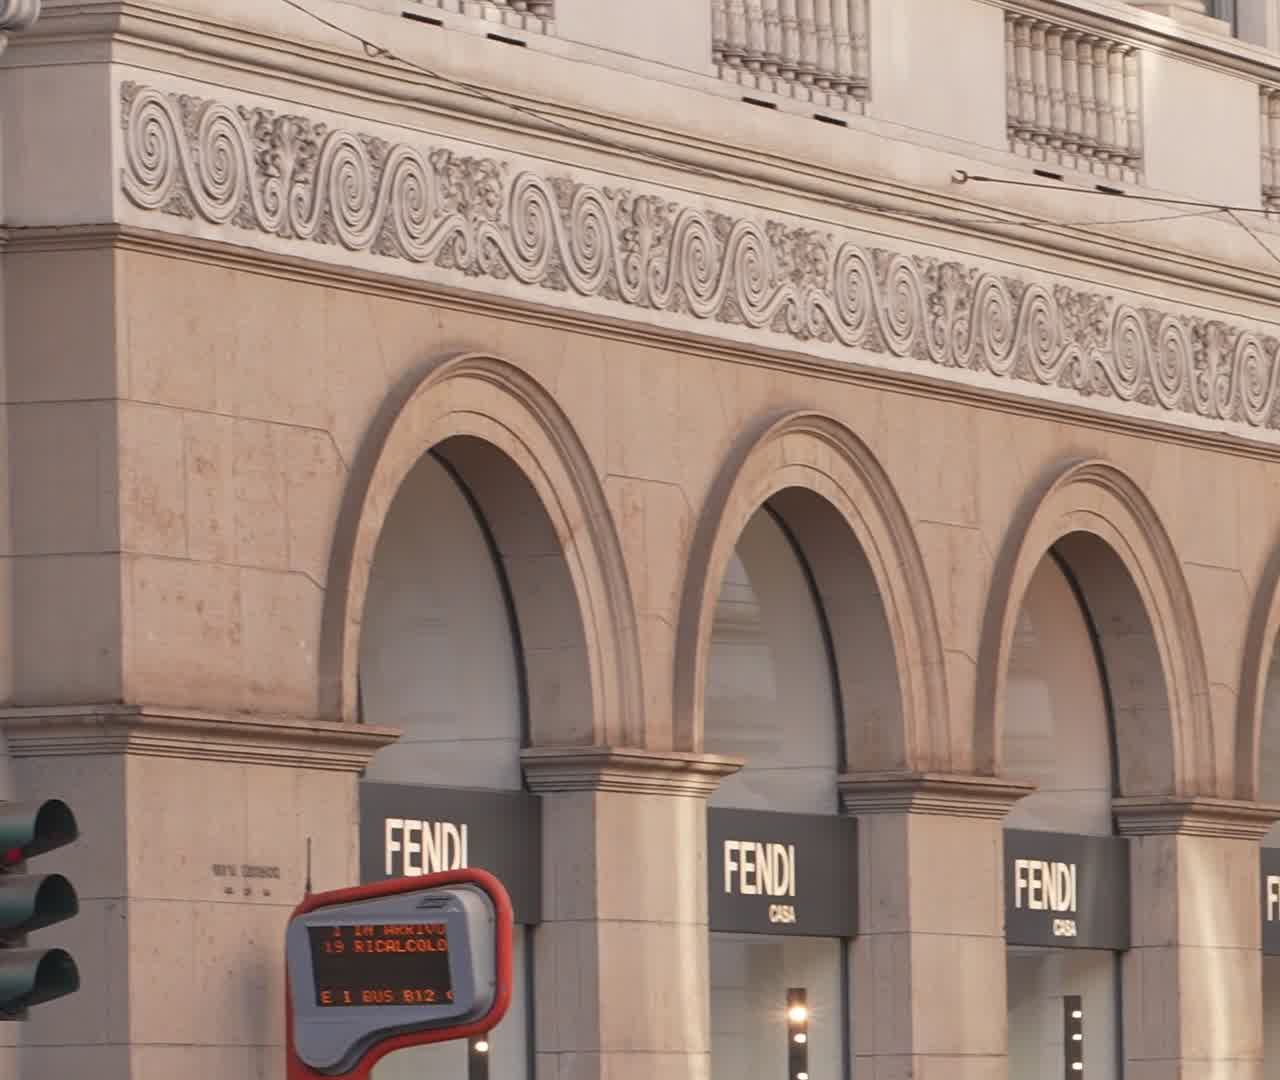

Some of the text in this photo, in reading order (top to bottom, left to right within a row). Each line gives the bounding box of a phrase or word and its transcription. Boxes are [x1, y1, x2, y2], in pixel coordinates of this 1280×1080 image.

[385, 818, 468, 877] FENDI
[724, 840, 796, 897] FENDI
[1015, 859, 1077, 912] FENDI
[769, 904, 797, 923] CASA
[353, 938, 449, 953] RICALCOLO
[362, 989, 393, 1003] BUS
